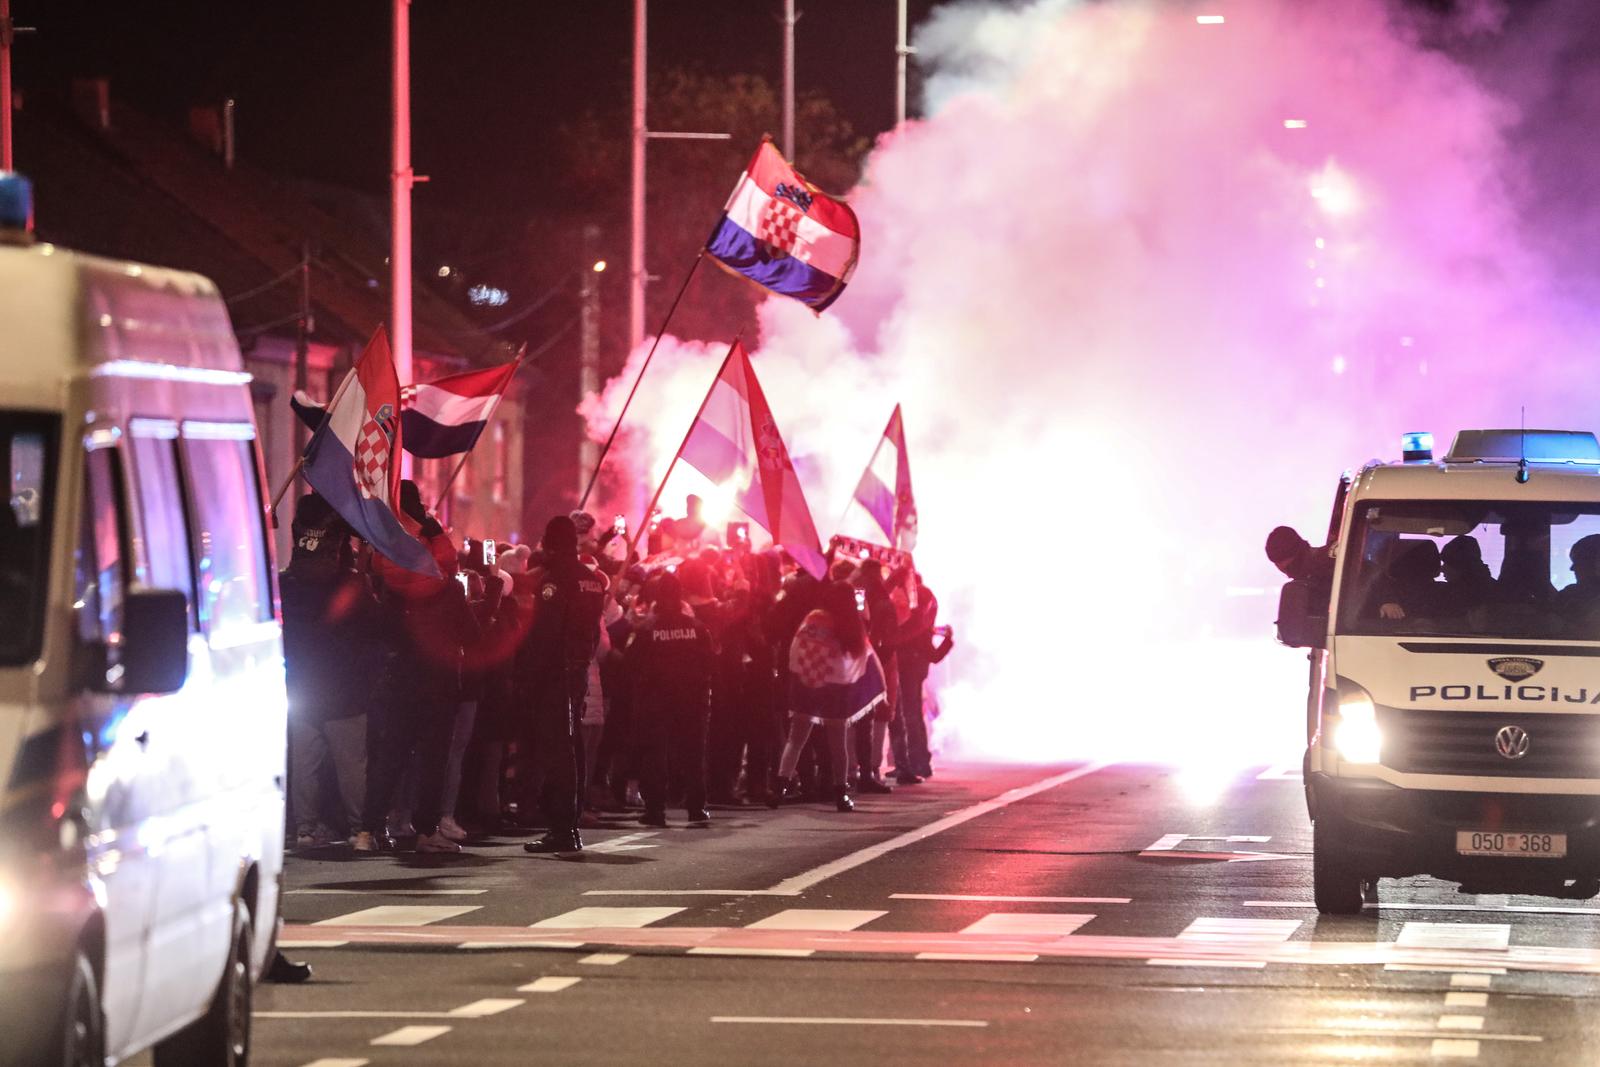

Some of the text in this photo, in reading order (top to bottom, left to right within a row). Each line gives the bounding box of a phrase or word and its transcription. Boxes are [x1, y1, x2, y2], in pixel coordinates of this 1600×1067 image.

[653, 628, 697, 641] POLICIJA
[1472, 833, 1551, 852] 050 368
